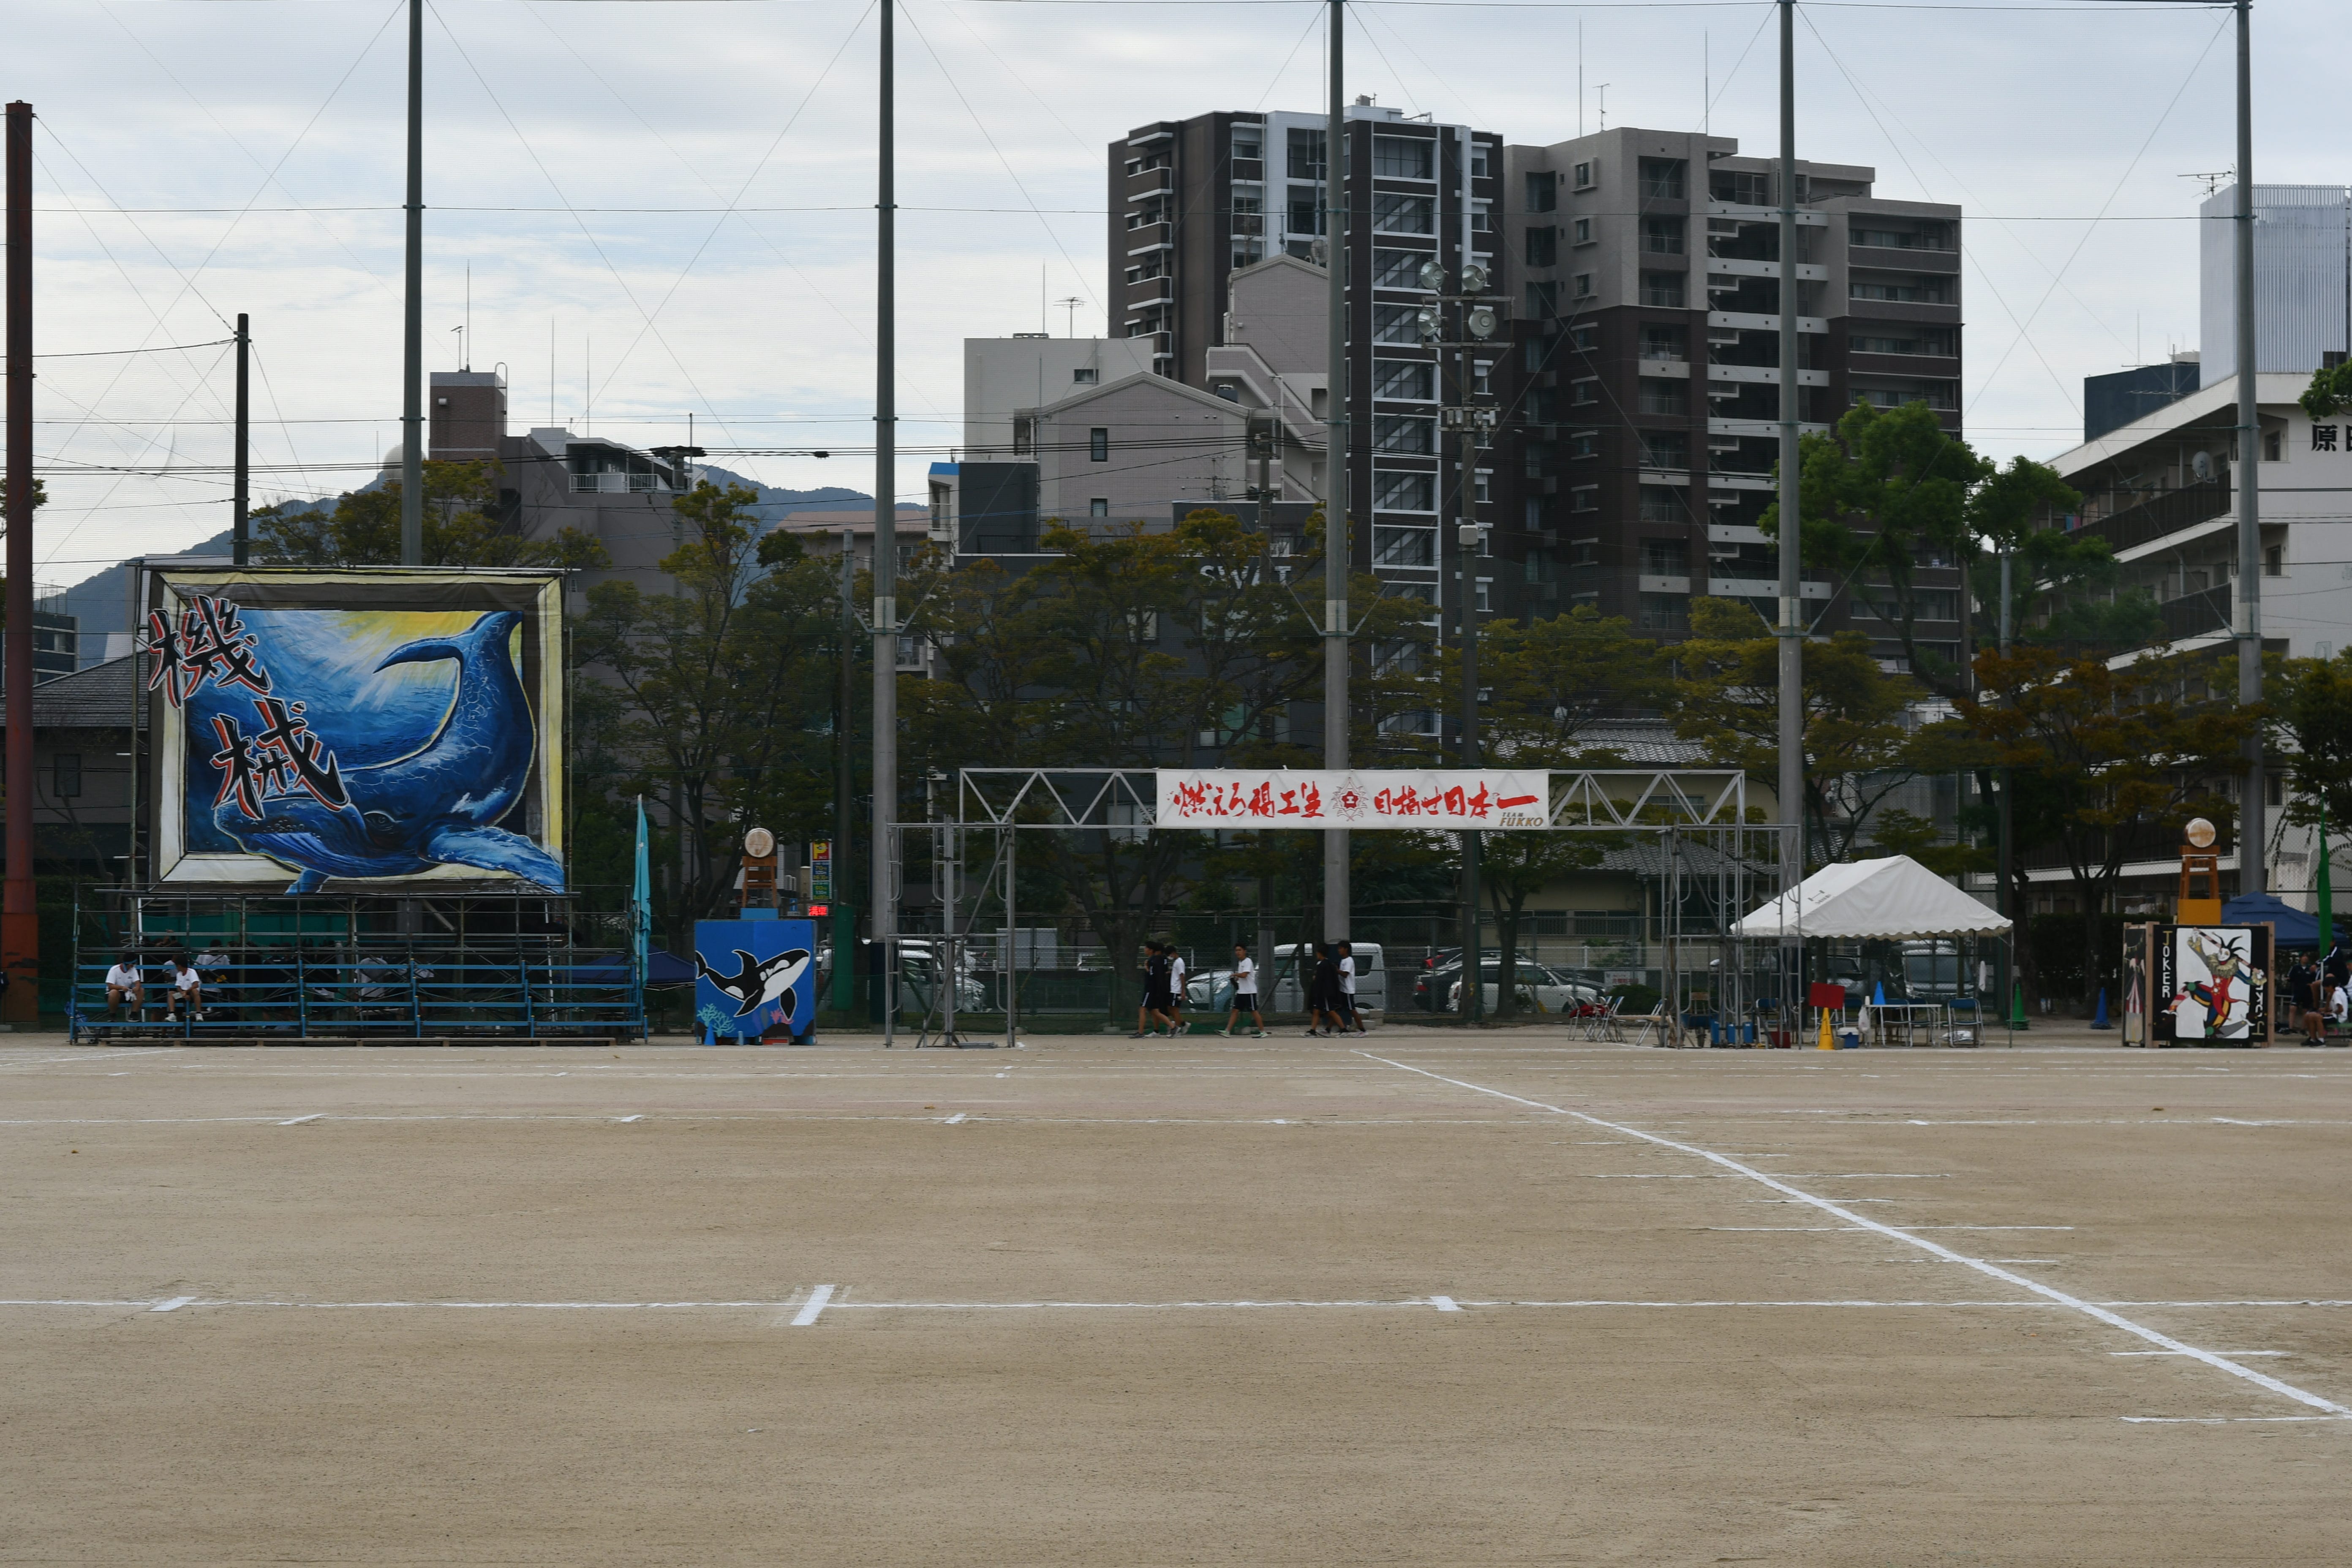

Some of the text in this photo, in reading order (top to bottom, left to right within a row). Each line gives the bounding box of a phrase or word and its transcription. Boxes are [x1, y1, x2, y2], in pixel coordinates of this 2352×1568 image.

[2311, 424, 2352, 452] 原
[1374, 781, 1539, 819] 目指せ日本一
[1500, 817, 1544, 827] FUKKO
[814, 842, 827, 860] P
[2162, 931, 2172, 998] JOKER
[2251, 985, 2265, 1035] JOK
